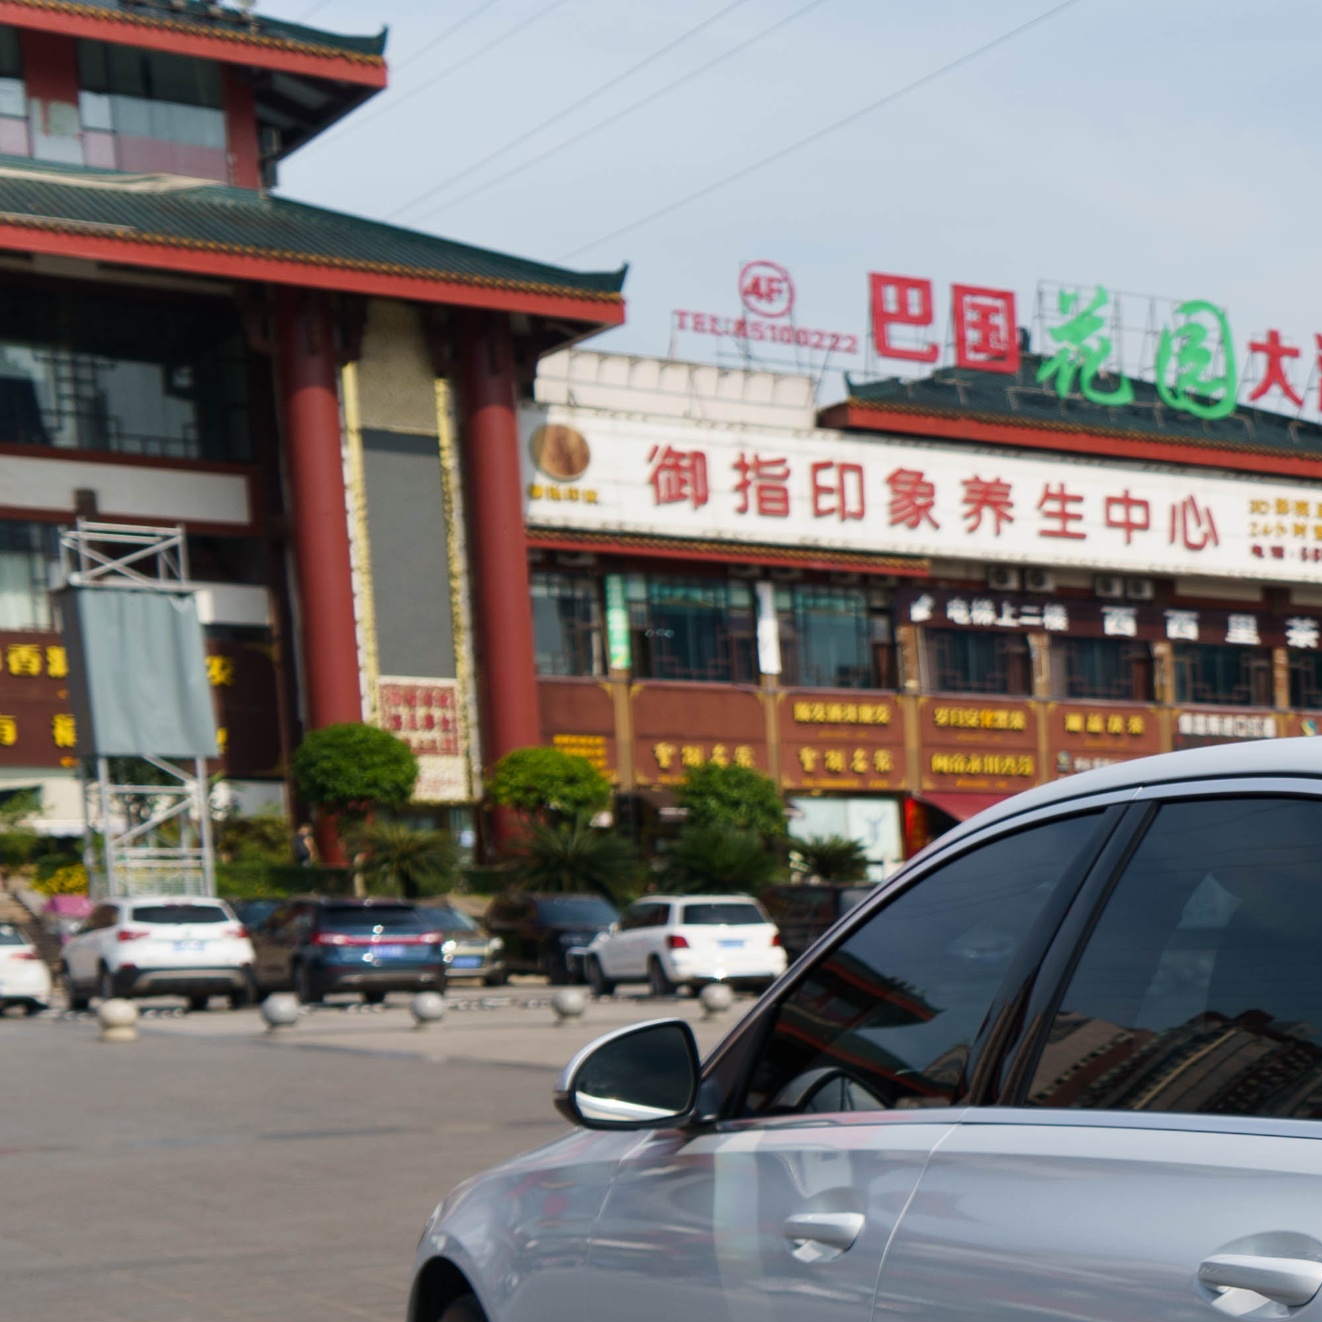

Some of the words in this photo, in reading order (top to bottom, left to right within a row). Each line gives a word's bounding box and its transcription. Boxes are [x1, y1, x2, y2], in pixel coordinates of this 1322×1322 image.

[648, 444, 1220, 551] 御指印象养生中心
